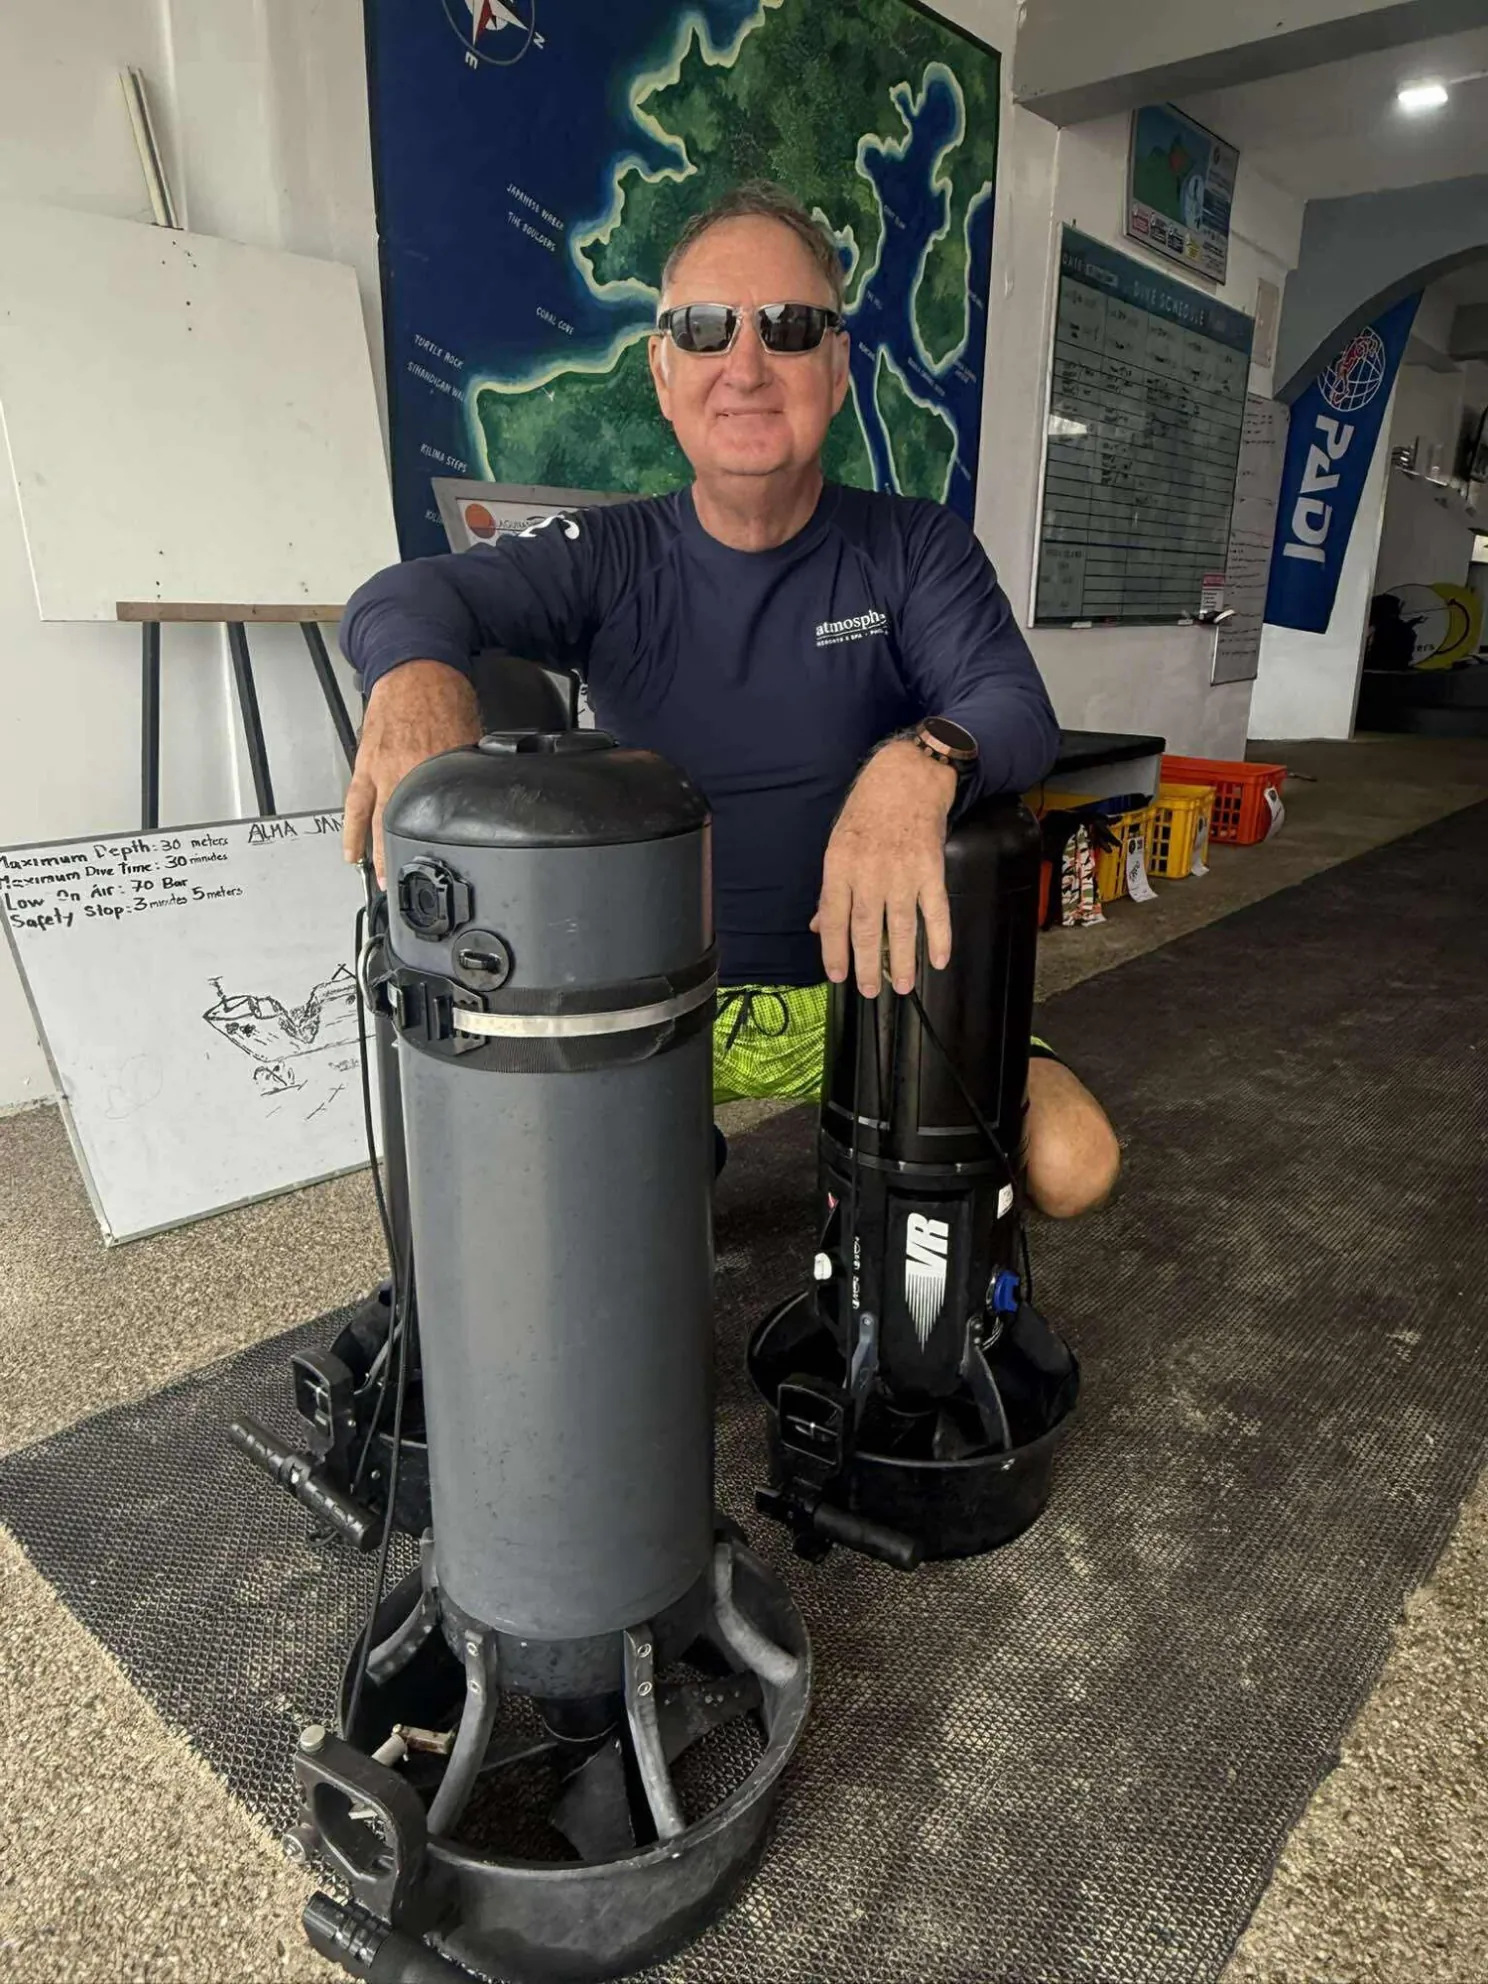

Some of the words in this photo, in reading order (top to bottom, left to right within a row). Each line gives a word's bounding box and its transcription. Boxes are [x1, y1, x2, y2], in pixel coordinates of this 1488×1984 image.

[533, 31, 545, 49] N
[465, 51, 478, 70] E
[507, 183, 540, 213] JAPANESE
[541, 208, 564, 231] WRECK
[508, 211, 521, 228] THE
[522, 223, 556, 252] BOULDERS
[536, 306, 556, 326] CORAL
[1133, 280, 1157, 308] DIVE
[1159, 291, 1205, 326] SCHEDULE
[414, 333, 443, 357] TURTLE
[443, 351, 464, 370] ROCK
[446, 456, 467, 473] STEPS
[1283, 414, 1354, 564] PADI
[248, 820, 298, 843] ALMA
[0, 854, 88, 870] Maximum
[160, 838, 181, 852] 30
[191, 833, 228, 848] meters
[0, 875, 81, 890] Maximum
[85, 865, 115, 877] Dive
[165, 855, 188, 869] 30
[189, 852, 228, 865] minutes
[4, 892, 44, 911] Low
[57, 889, 80, 901] On
[131, 879, 154, 892] 70
[162, 877, 188, 890] Bar
[10, 907, 73, 931] Safety
[133, 897, 148, 911] 3
[149, 893, 188, 908] minutes
[192, 887, 205, 900] 5
[206, 886, 243, 899] meters
